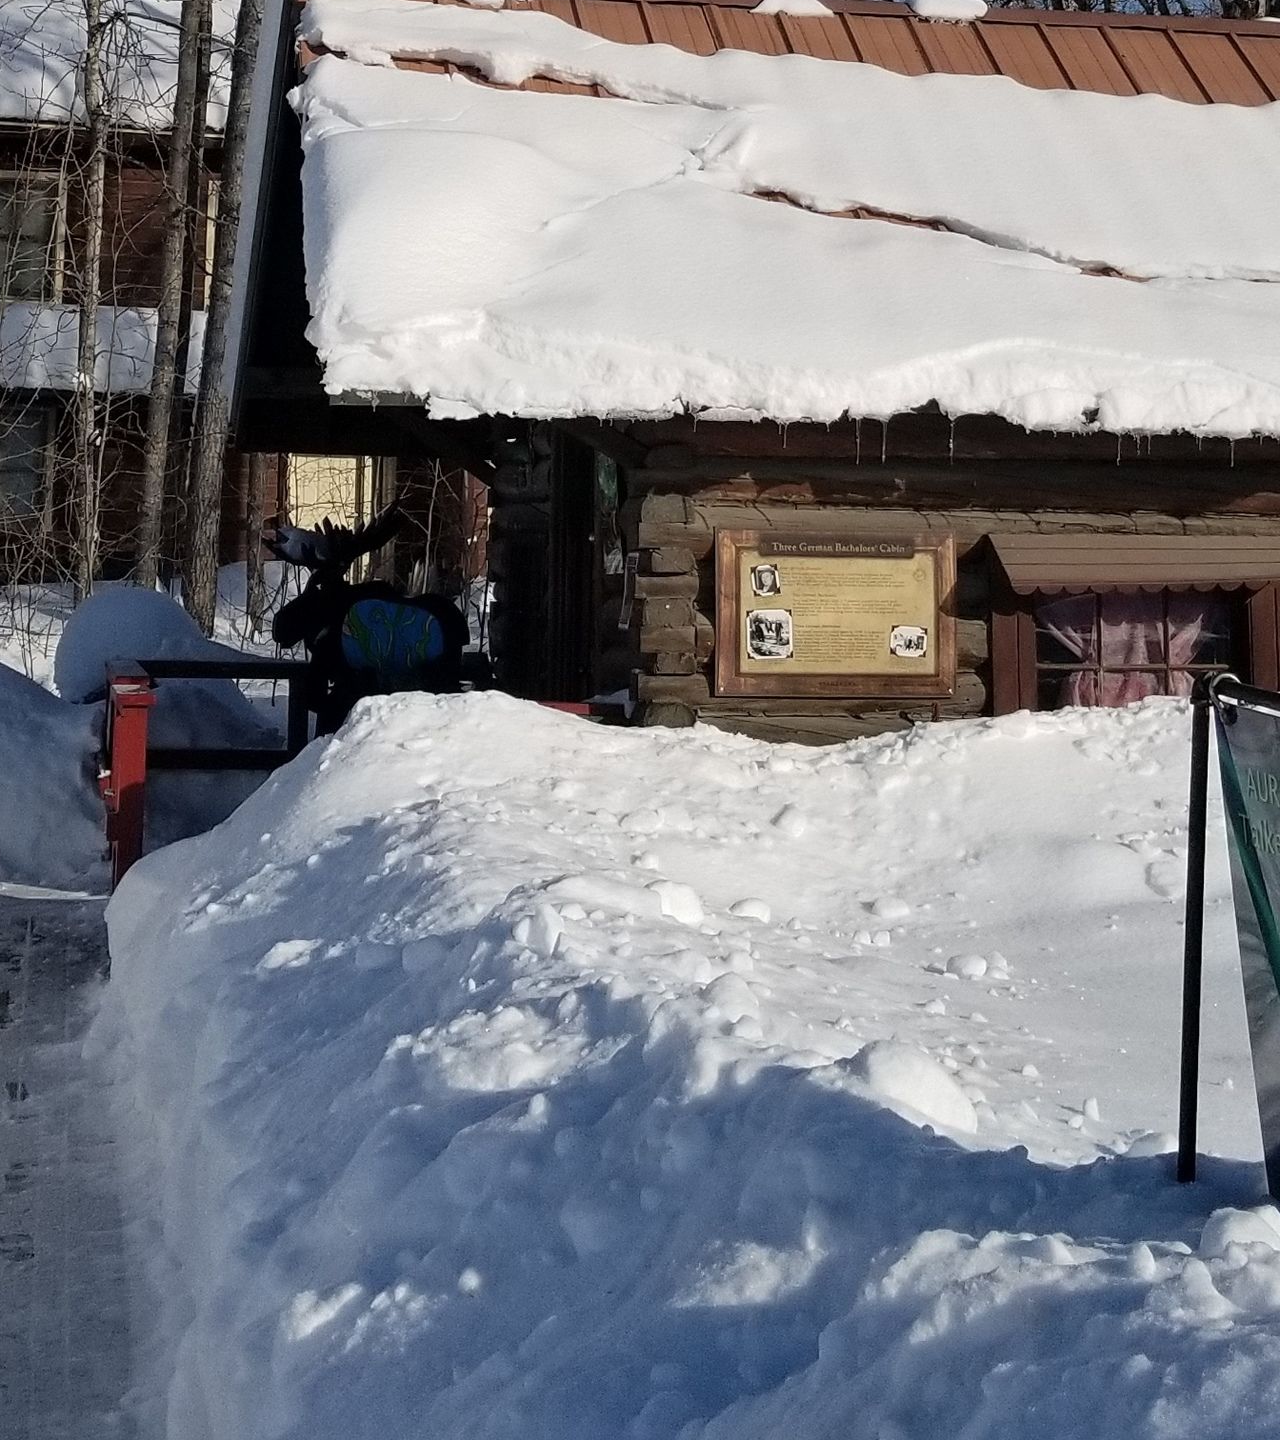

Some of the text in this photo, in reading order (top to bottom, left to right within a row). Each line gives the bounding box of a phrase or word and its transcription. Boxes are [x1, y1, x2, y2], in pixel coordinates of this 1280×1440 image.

[772, 542, 797, 552] Three
[799, 542, 833, 552] German
[880, 544, 905, 553] Cabin
